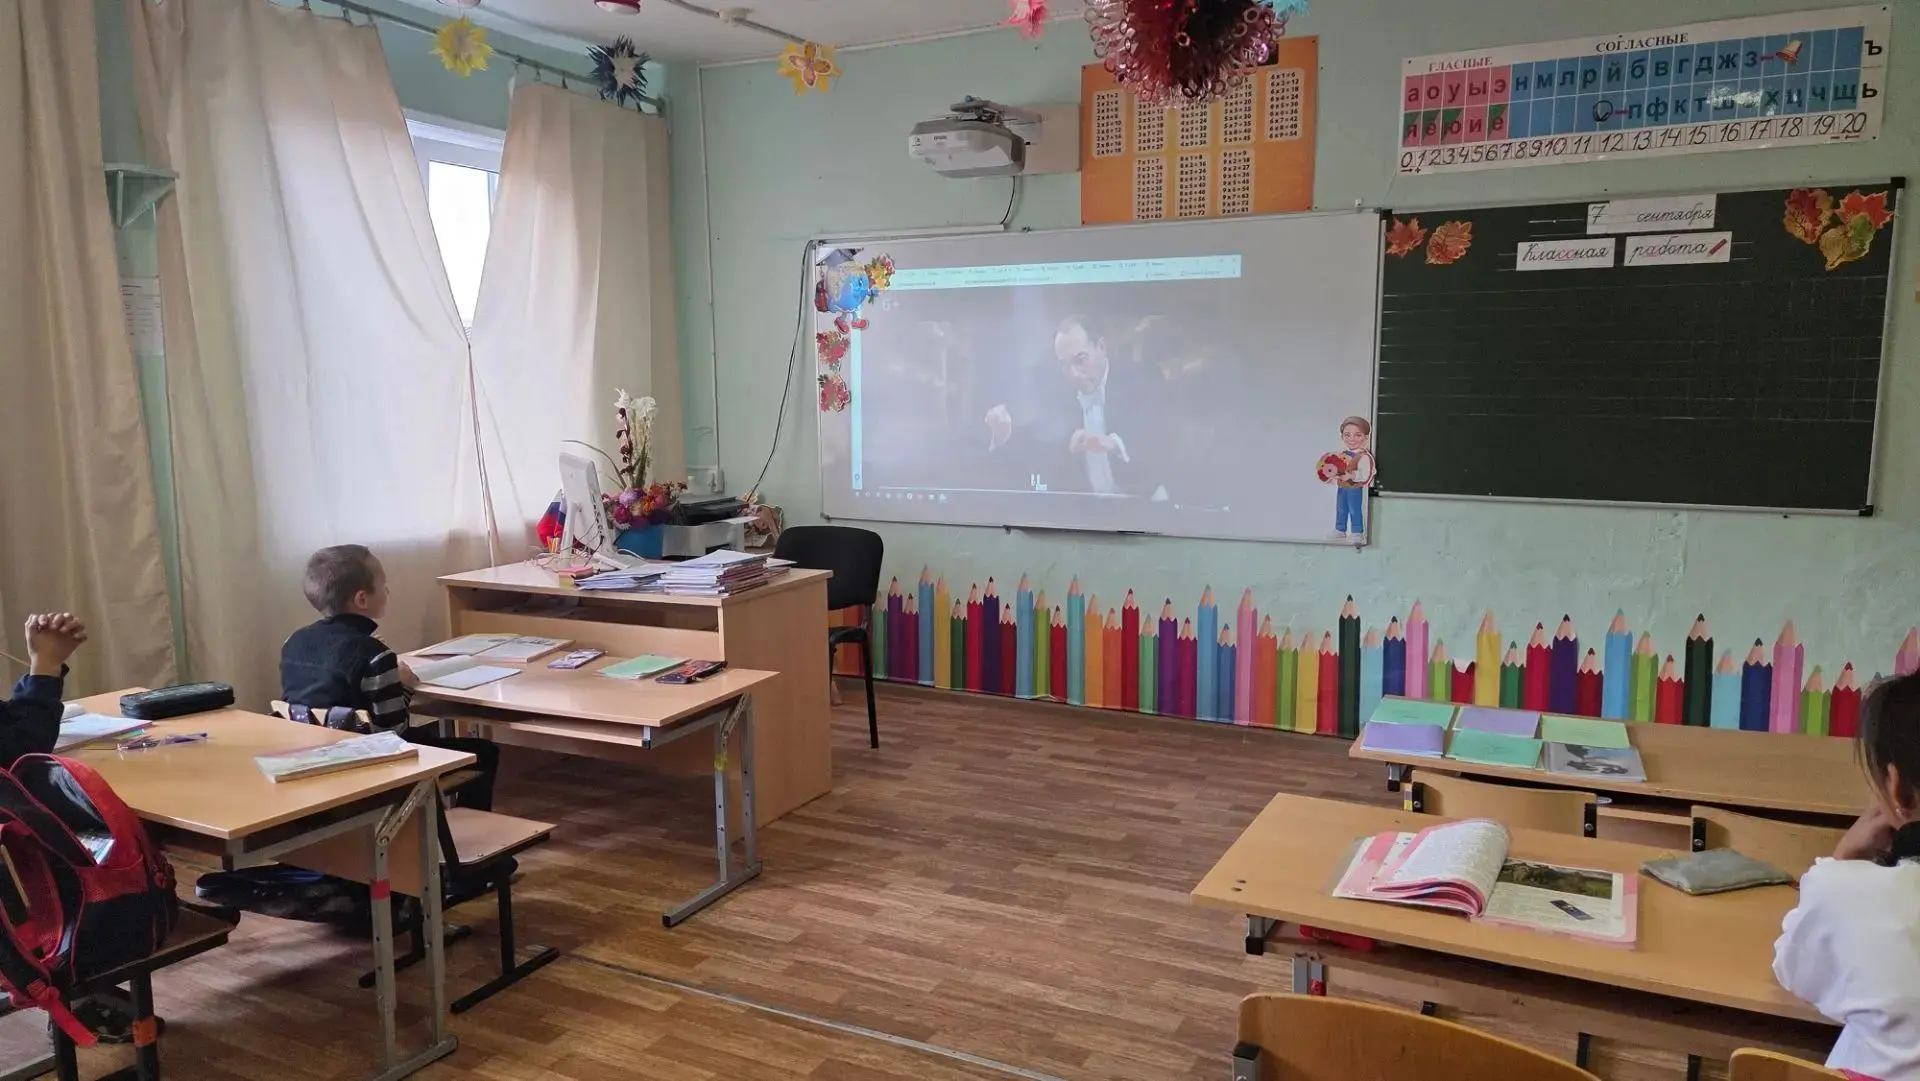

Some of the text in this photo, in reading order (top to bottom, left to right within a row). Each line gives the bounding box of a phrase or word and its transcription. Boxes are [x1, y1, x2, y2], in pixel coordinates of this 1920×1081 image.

[1596, 33, 1689, 53] СОГЛАСНЫЕ
[1429, 57, 1493, 72] ГЛАСНЫЕ
[1591, 201, 1714, 226] 7 сентября
[1521, 236, 1708, 264] Классная работа
